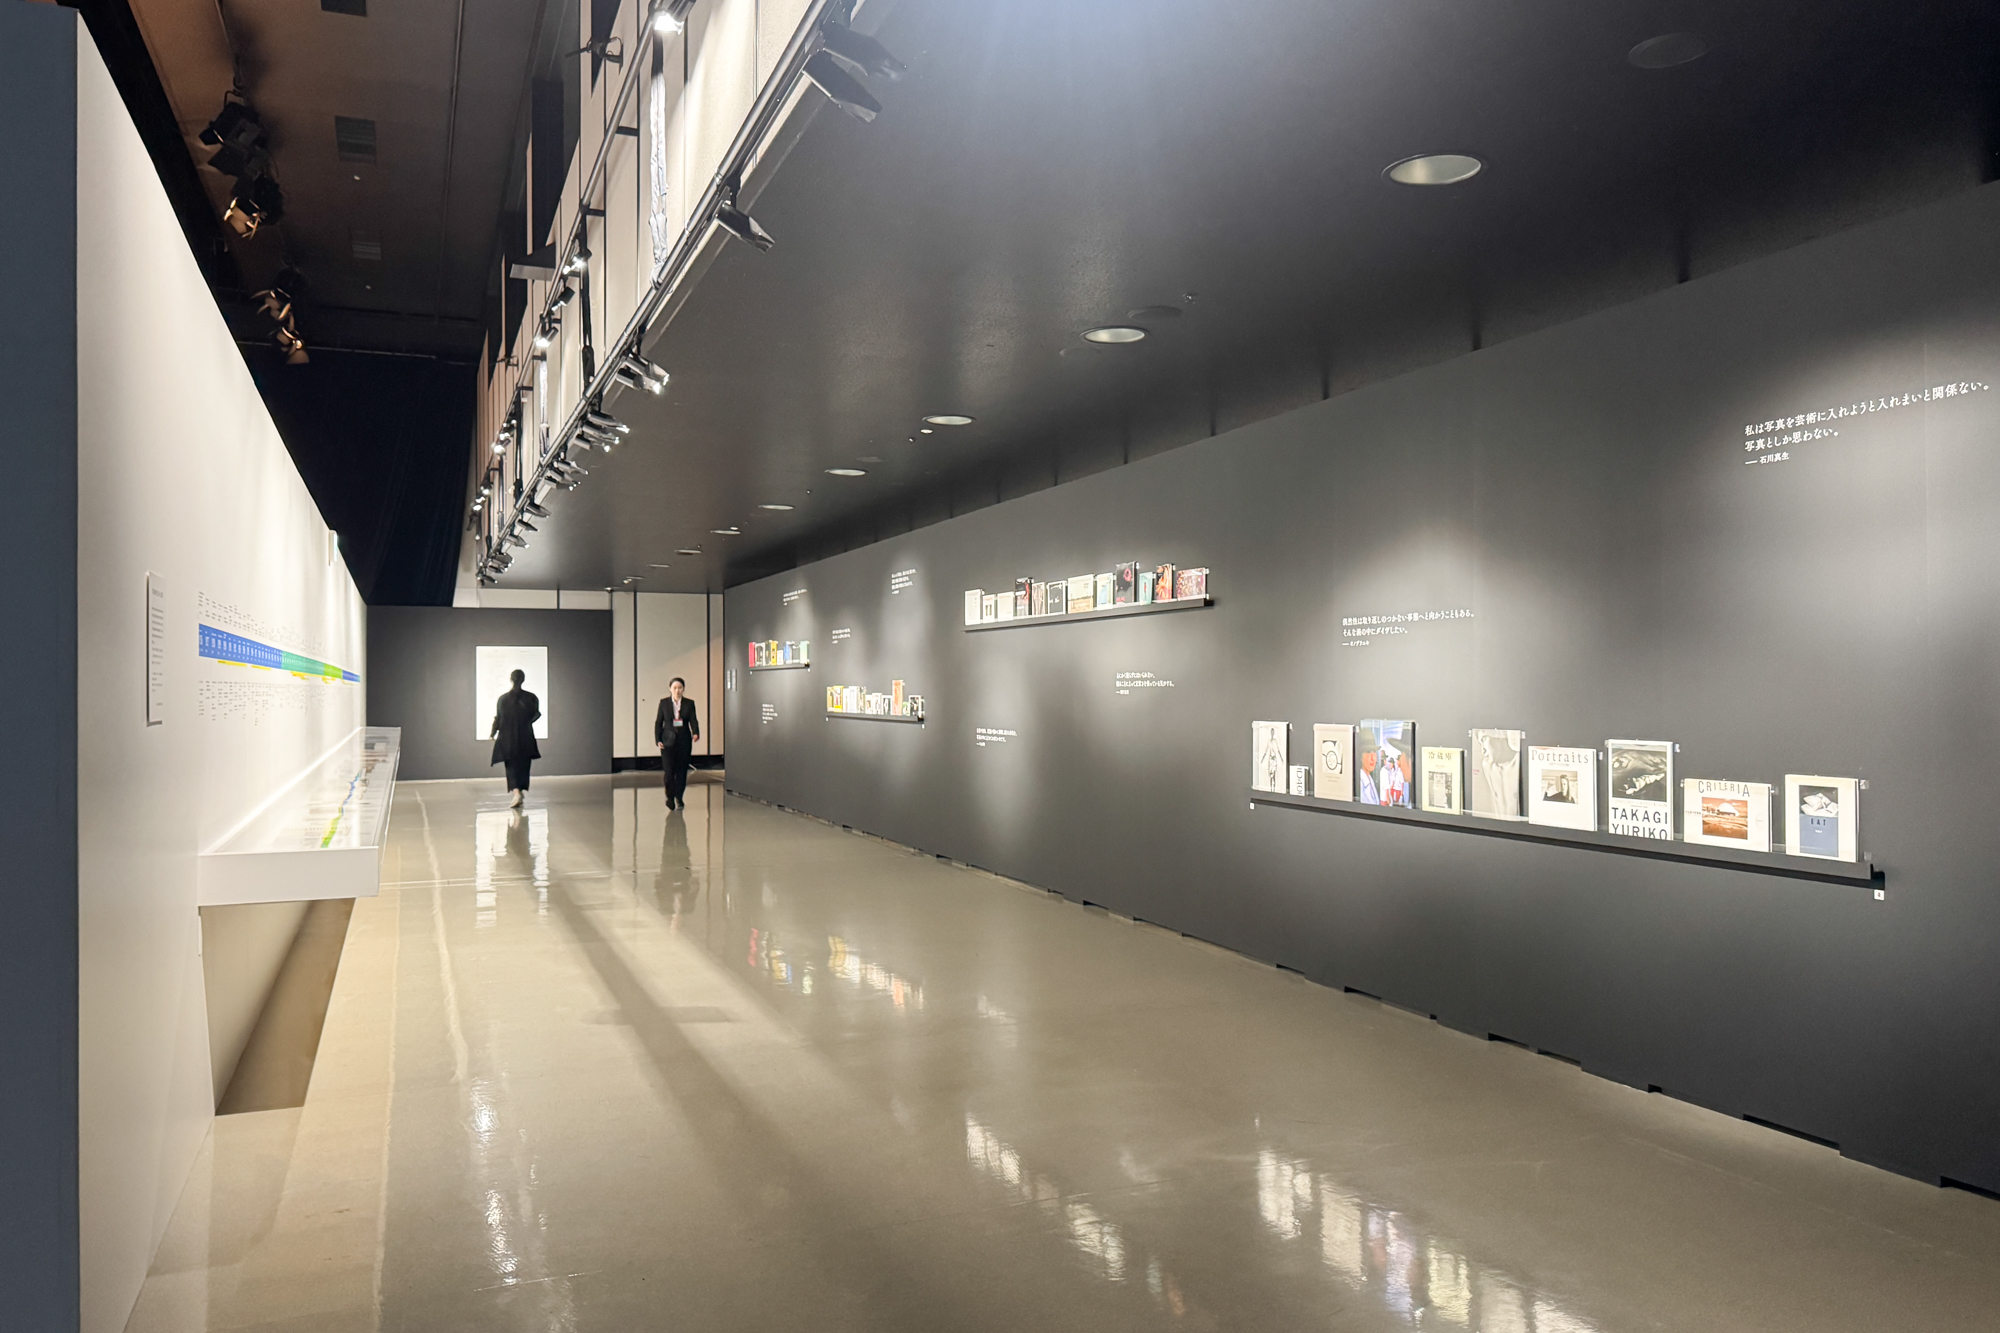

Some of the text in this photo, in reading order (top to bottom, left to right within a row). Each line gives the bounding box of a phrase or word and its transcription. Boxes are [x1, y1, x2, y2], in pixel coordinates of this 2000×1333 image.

[1744, 381, 1990, 437] 私は写真を芸術に入れようと入れまいと関係ない。
[1744, 427, 1839, 452] 写真としか思わない。
[1531, 749, 1589, 764] Portraits
[1698, 780, 1750, 797] CRITERIA
[1611, 807, 1668, 825] TAKAGI
[1810, 818, 1826, 826] EAT
[1611, 823, 1668, 840] YURIKO
